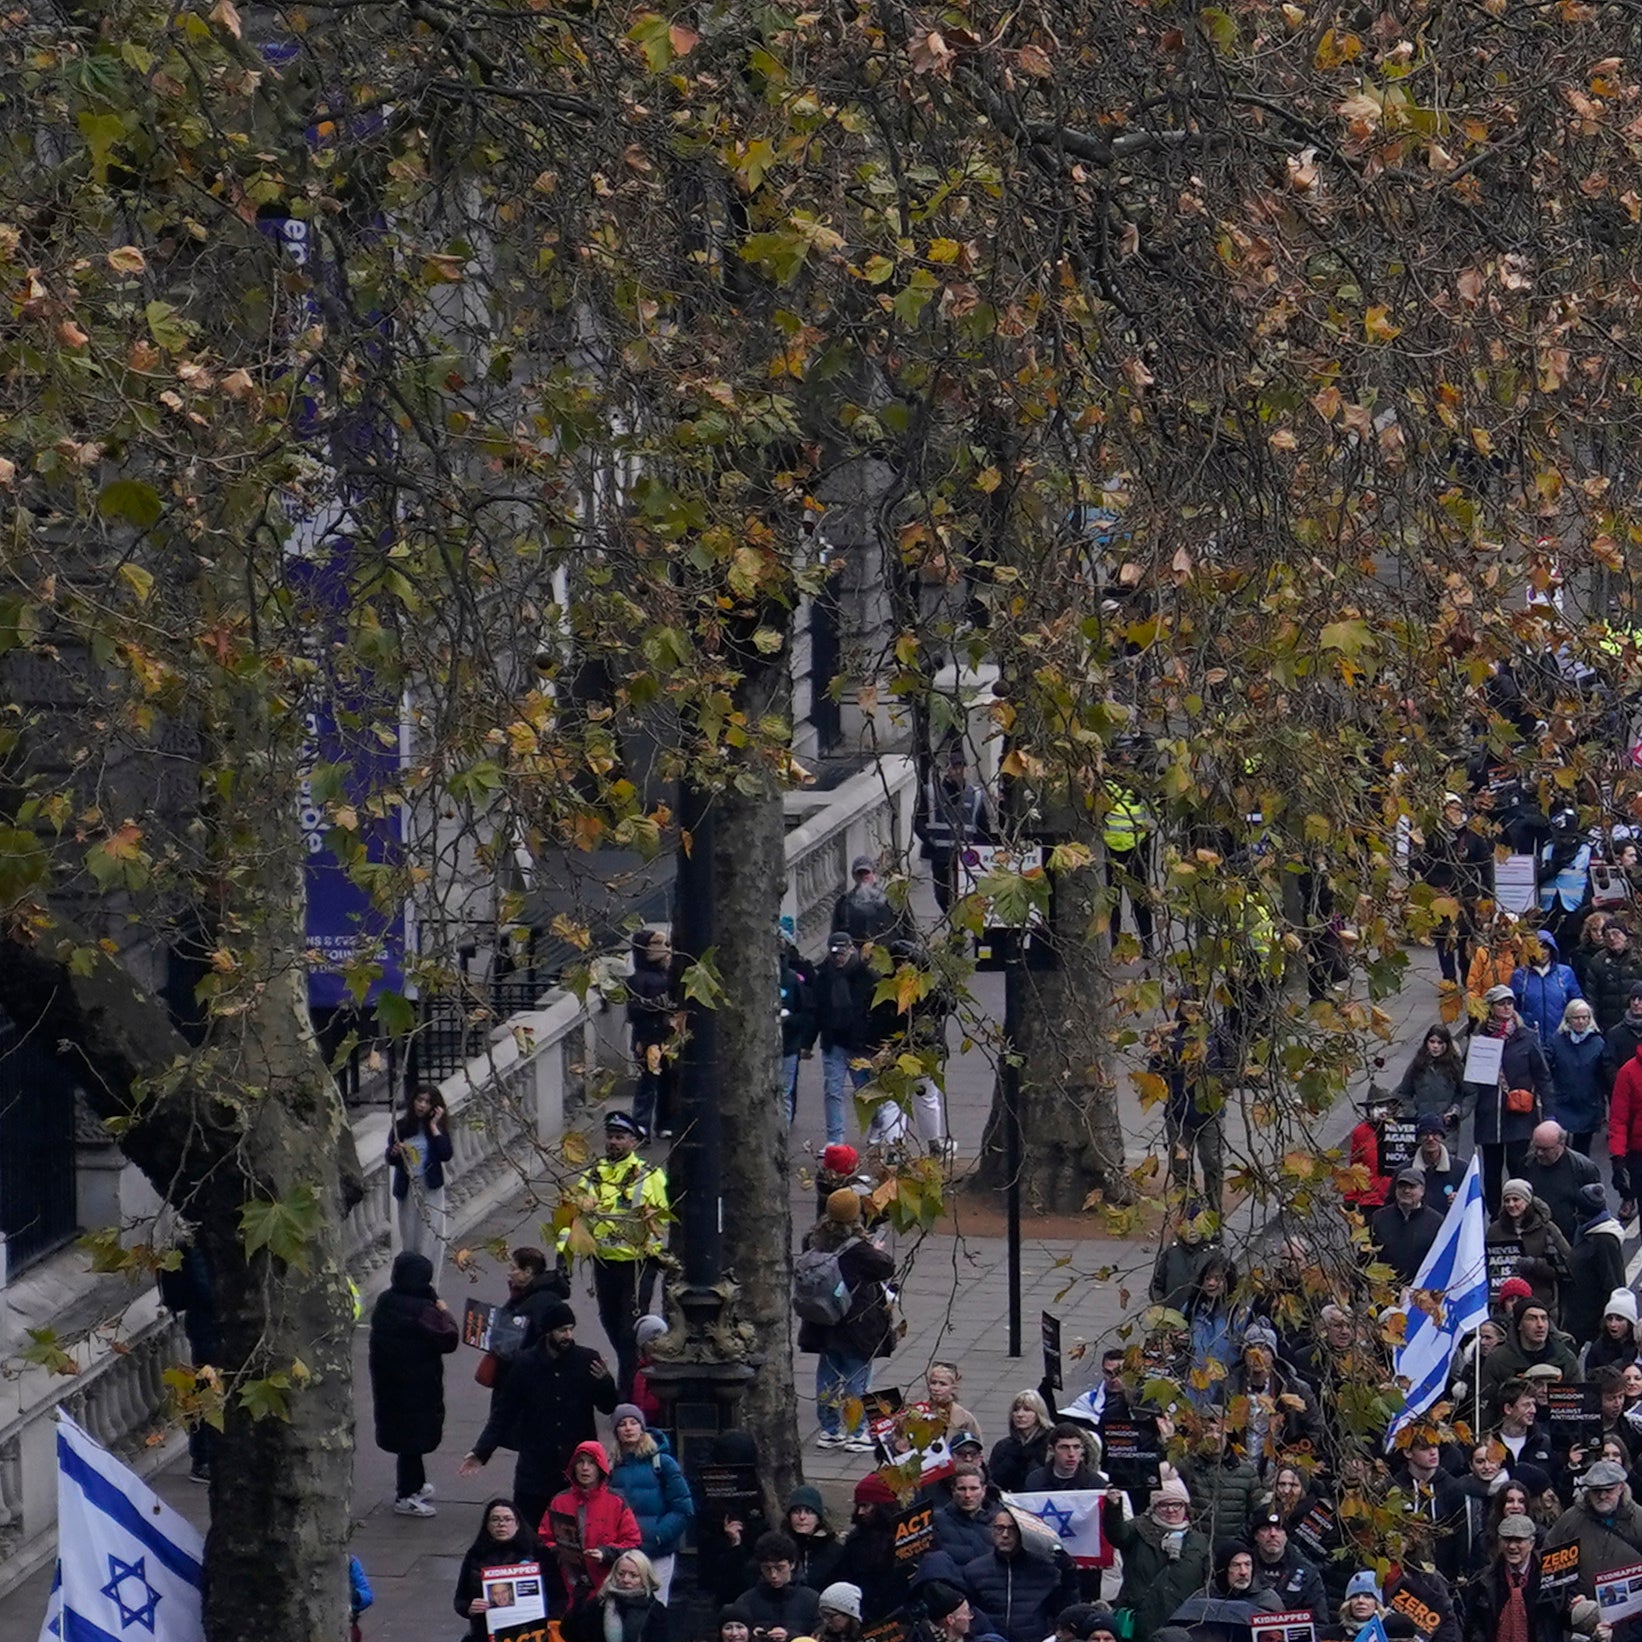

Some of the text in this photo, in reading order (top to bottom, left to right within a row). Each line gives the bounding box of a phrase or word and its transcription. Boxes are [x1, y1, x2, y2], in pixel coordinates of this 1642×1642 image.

[1384, 1134, 1417, 1143] AGAIN
[896, 1509, 932, 1539] ACT
[1541, 1549, 1579, 1570] ZERO
[484, 1566, 540, 1579] KIDNAPPED
[1253, 1614, 1311, 1625] KIDNAPPED
